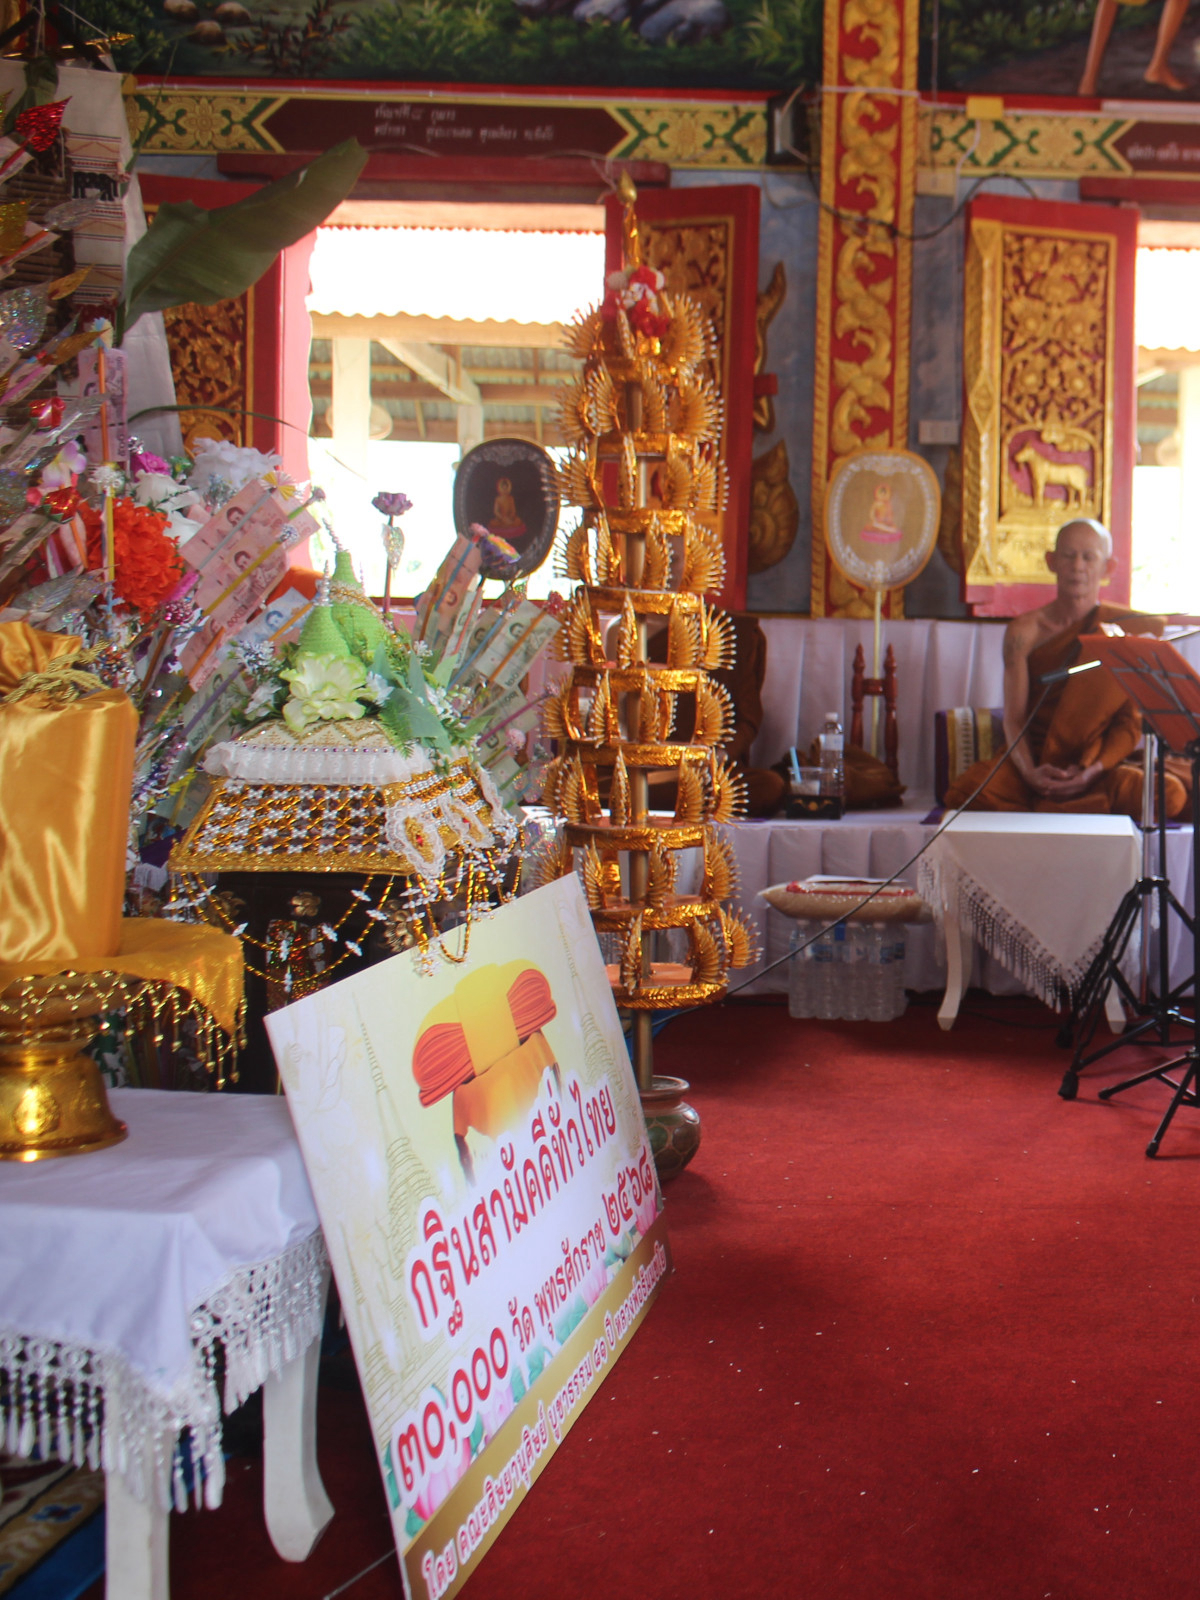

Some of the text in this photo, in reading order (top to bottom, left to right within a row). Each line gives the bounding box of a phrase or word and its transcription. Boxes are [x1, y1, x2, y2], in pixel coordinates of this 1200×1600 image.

[398, 1147, 654, 1491] ๓๐,๐๐๐ วัด พุทธศักราช ๒๕๖๘
[411, 1080, 616, 1337] กฐินสามัคคีทั่วไทย
[423, 1545, 457, 1598] โดย
[458, 1402, 547, 1563] คณะศิษยานุศิษย์
[548, 1354, 593, 1442] บูชาธรรม
[604, 1312, 616, 1349] ปี
